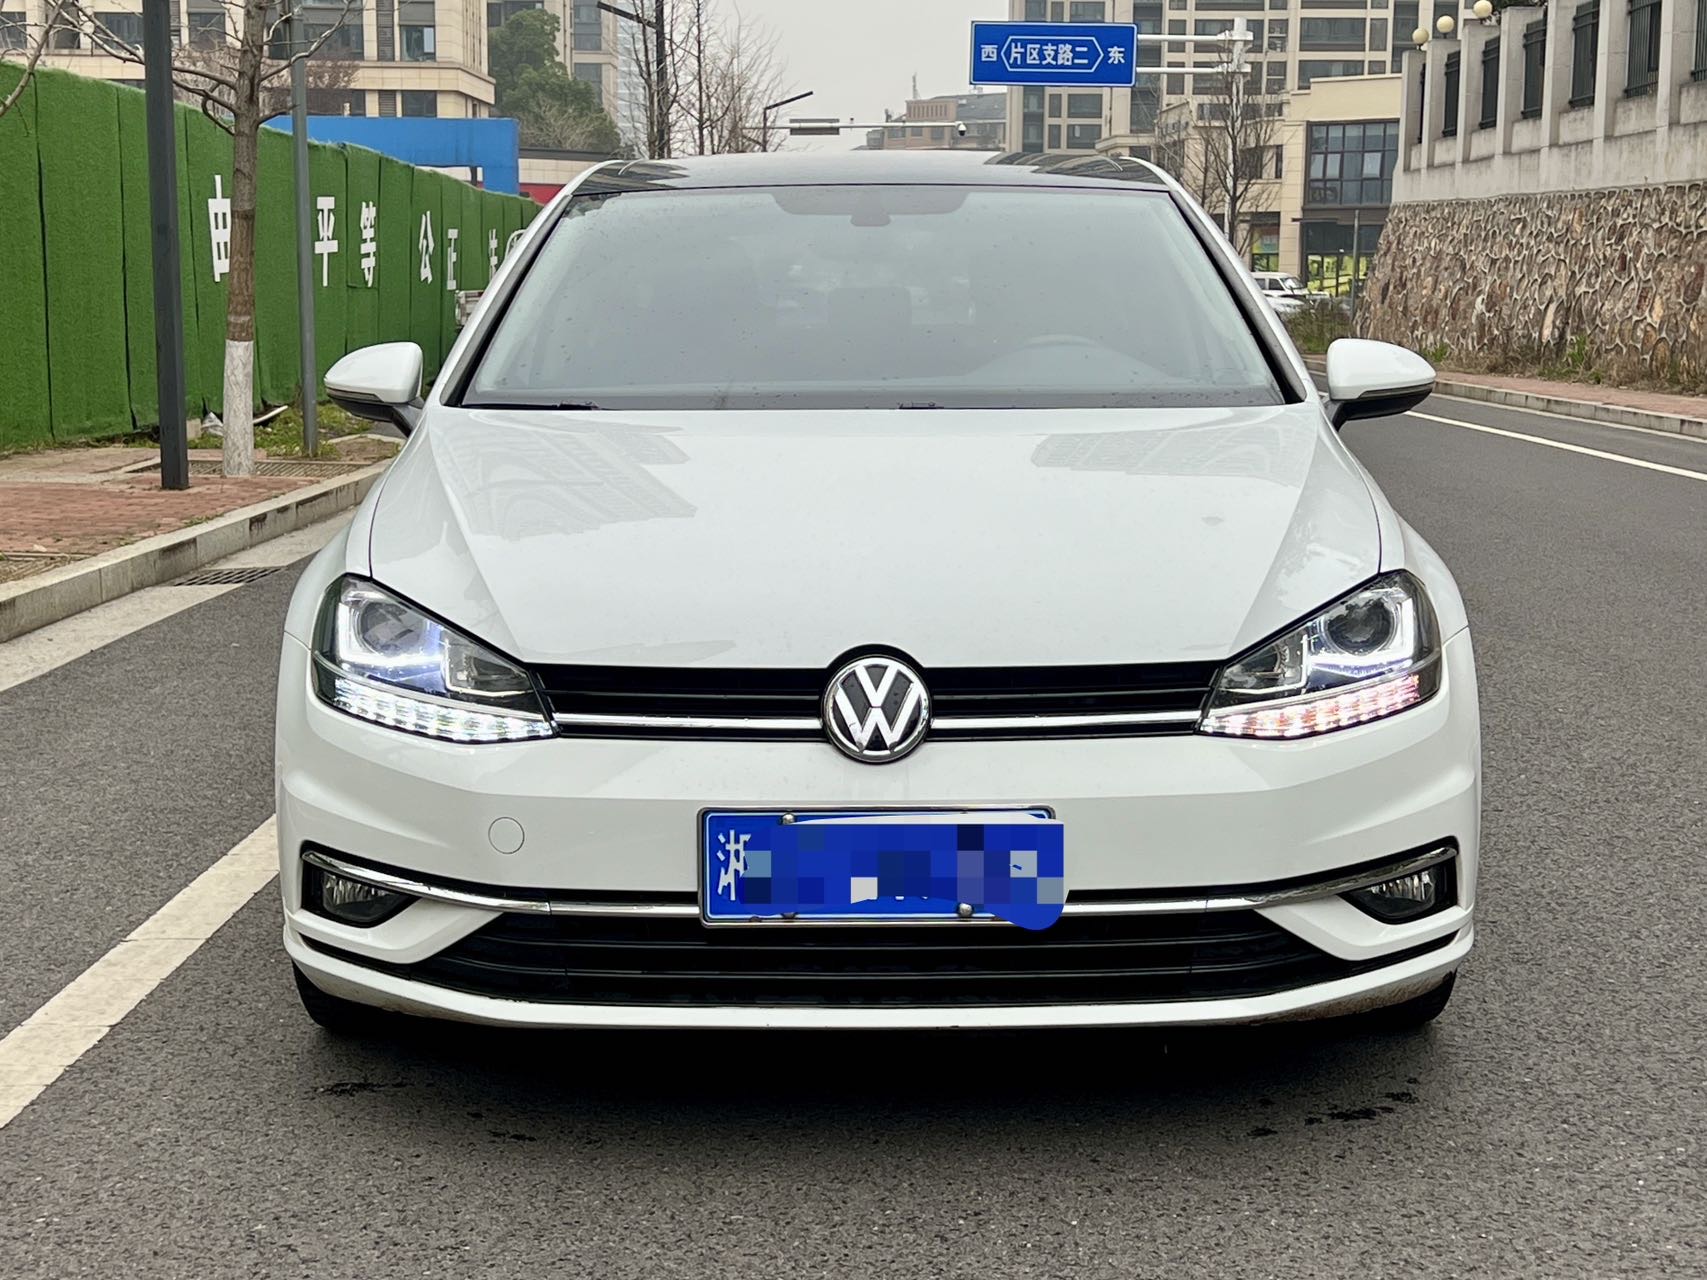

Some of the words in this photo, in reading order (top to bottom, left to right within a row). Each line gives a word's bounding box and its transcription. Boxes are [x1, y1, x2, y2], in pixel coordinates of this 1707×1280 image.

[980, 44, 998, 62] 西
[1009, 42, 1089, 66] 片区支路二
[1107, 46, 1126, 65] 东
[314, 196, 376, 288] 平等
[418, 210, 458, 290] 公正
